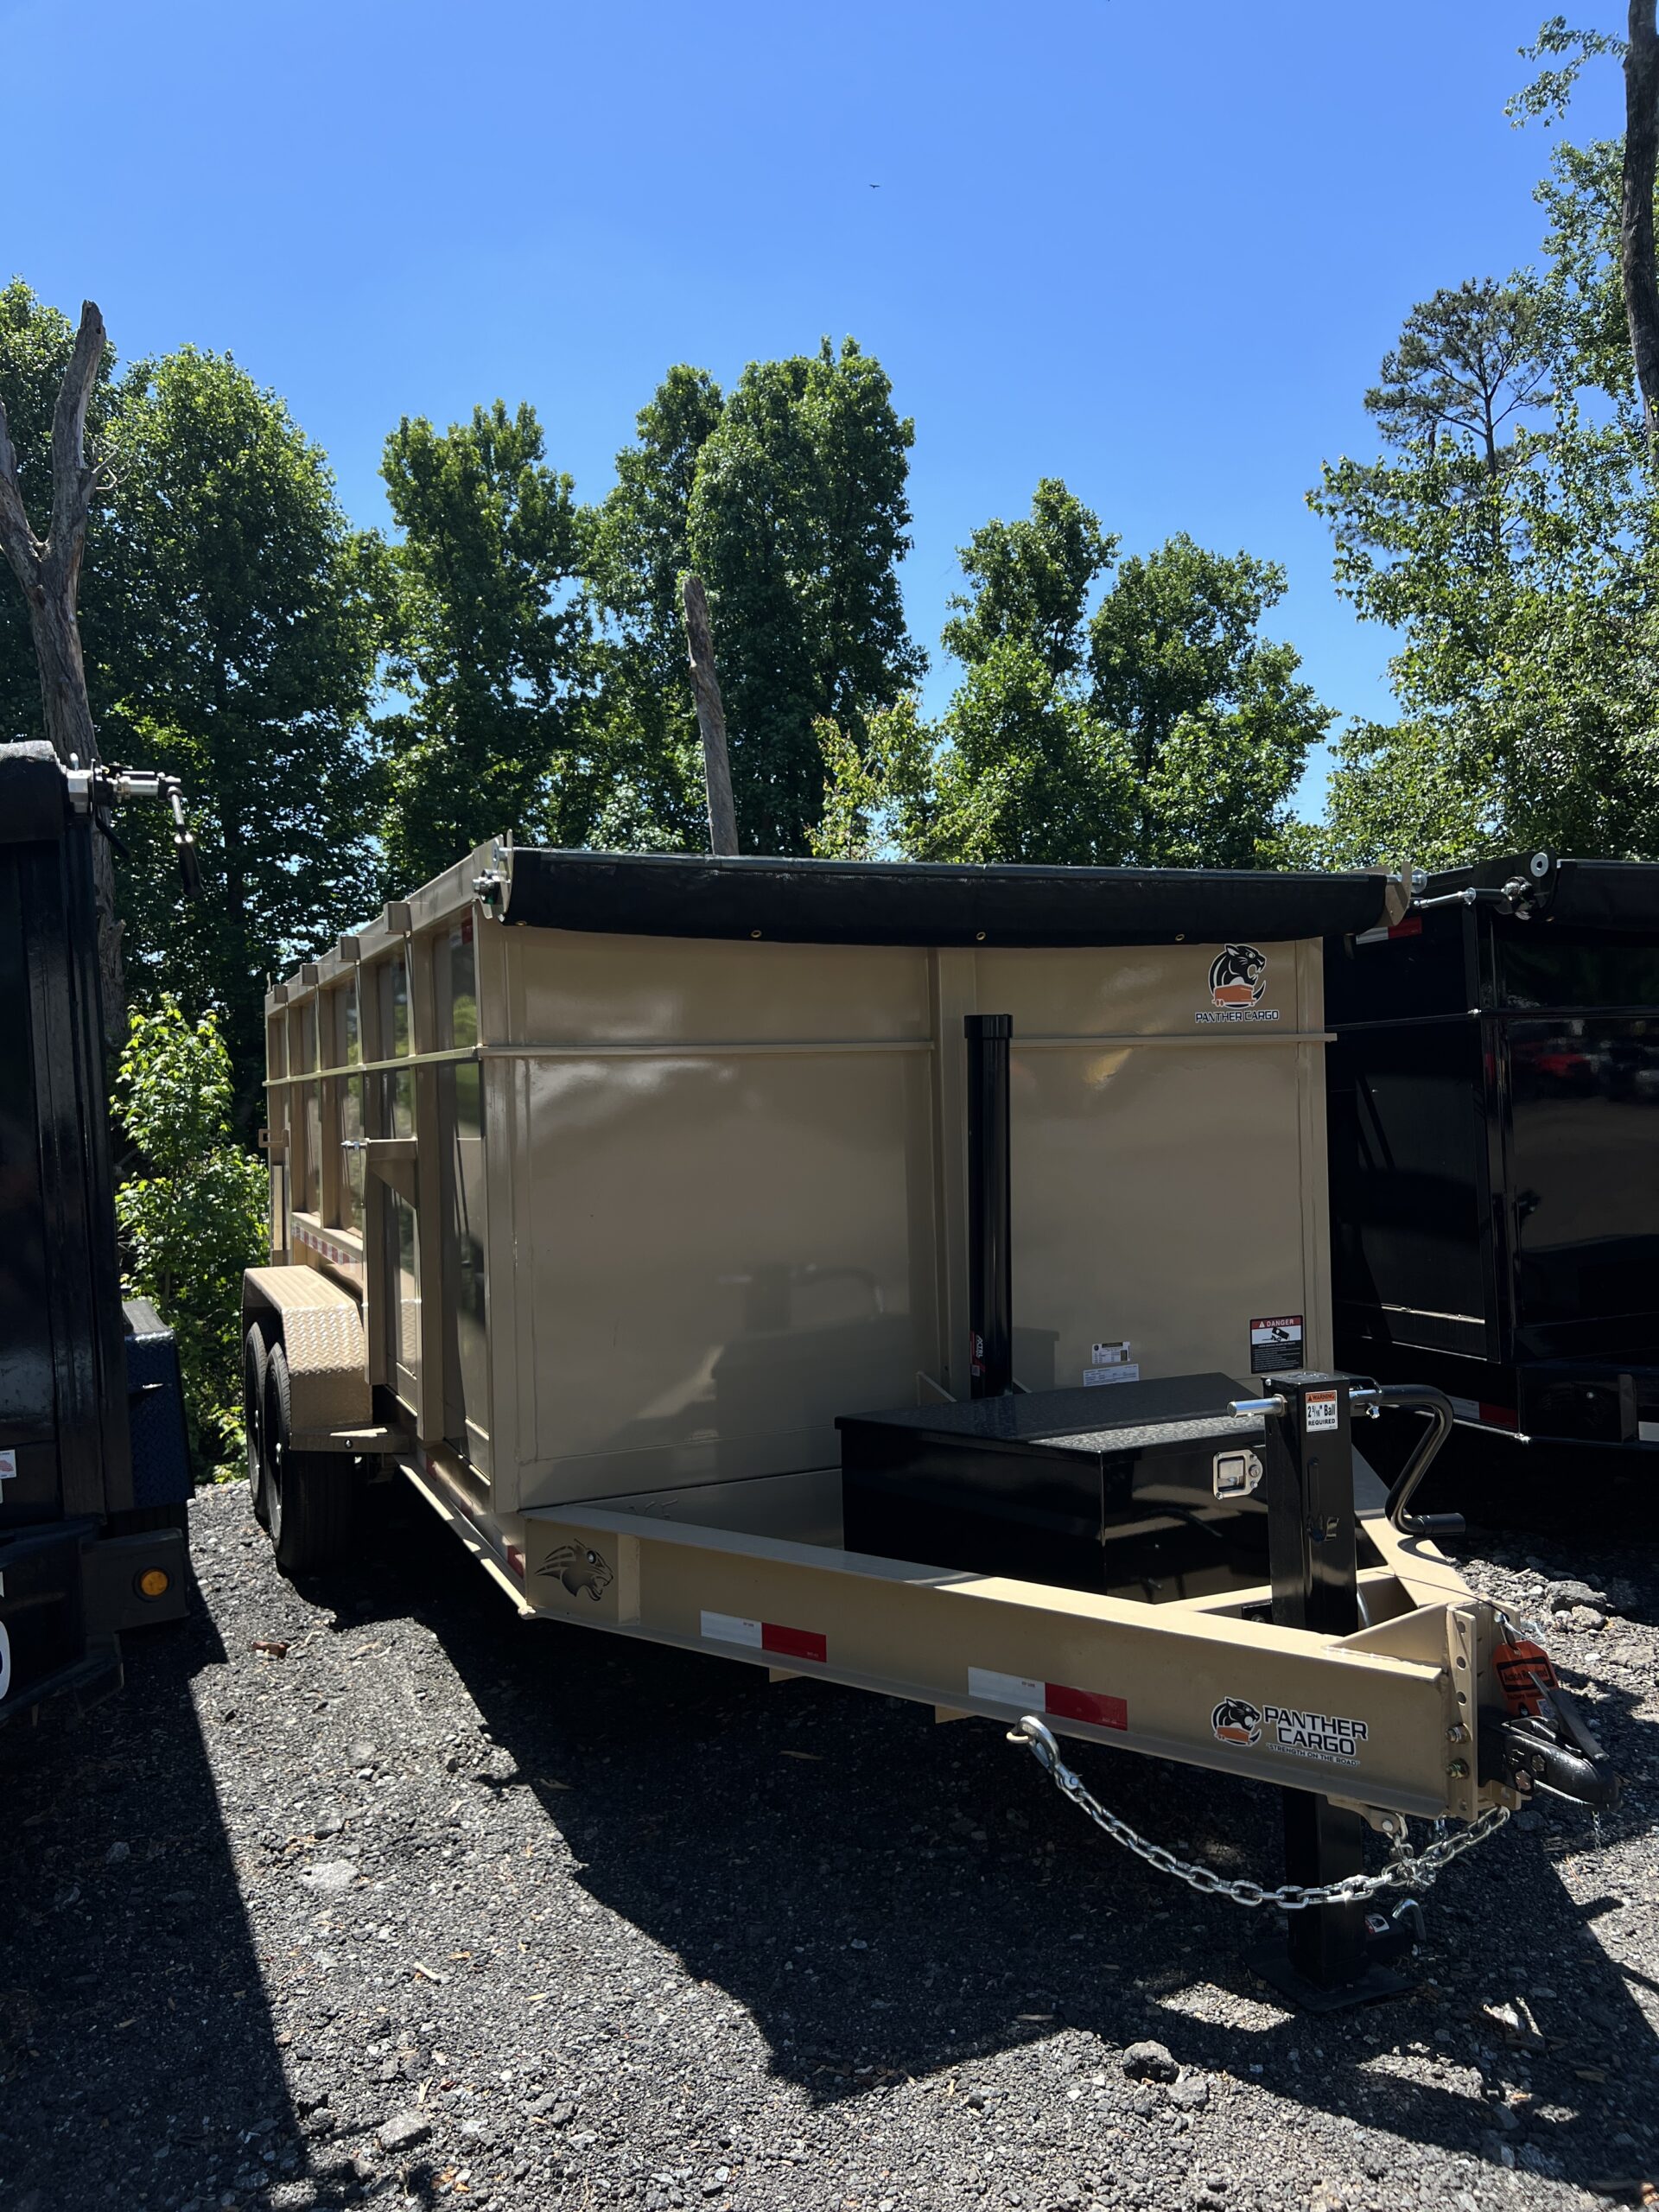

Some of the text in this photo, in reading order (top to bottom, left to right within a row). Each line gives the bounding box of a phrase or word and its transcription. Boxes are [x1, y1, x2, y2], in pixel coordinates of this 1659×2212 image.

[1196, 1010, 1280, 1023] PANTHER CARGO
[1266, 1319, 1294, 1327] DANGER
[1313, 1392, 1335, 1401] WARNING
[1324, 1403, 1336, 1416] Ball
[1307, 1418, 1336, 1427] REQUIRED
[1263, 1706, 1368, 1740] PANTHER
[1277, 1726, 1356, 1757] CARGO
[1319, 1754, 1334, 1763] THE
